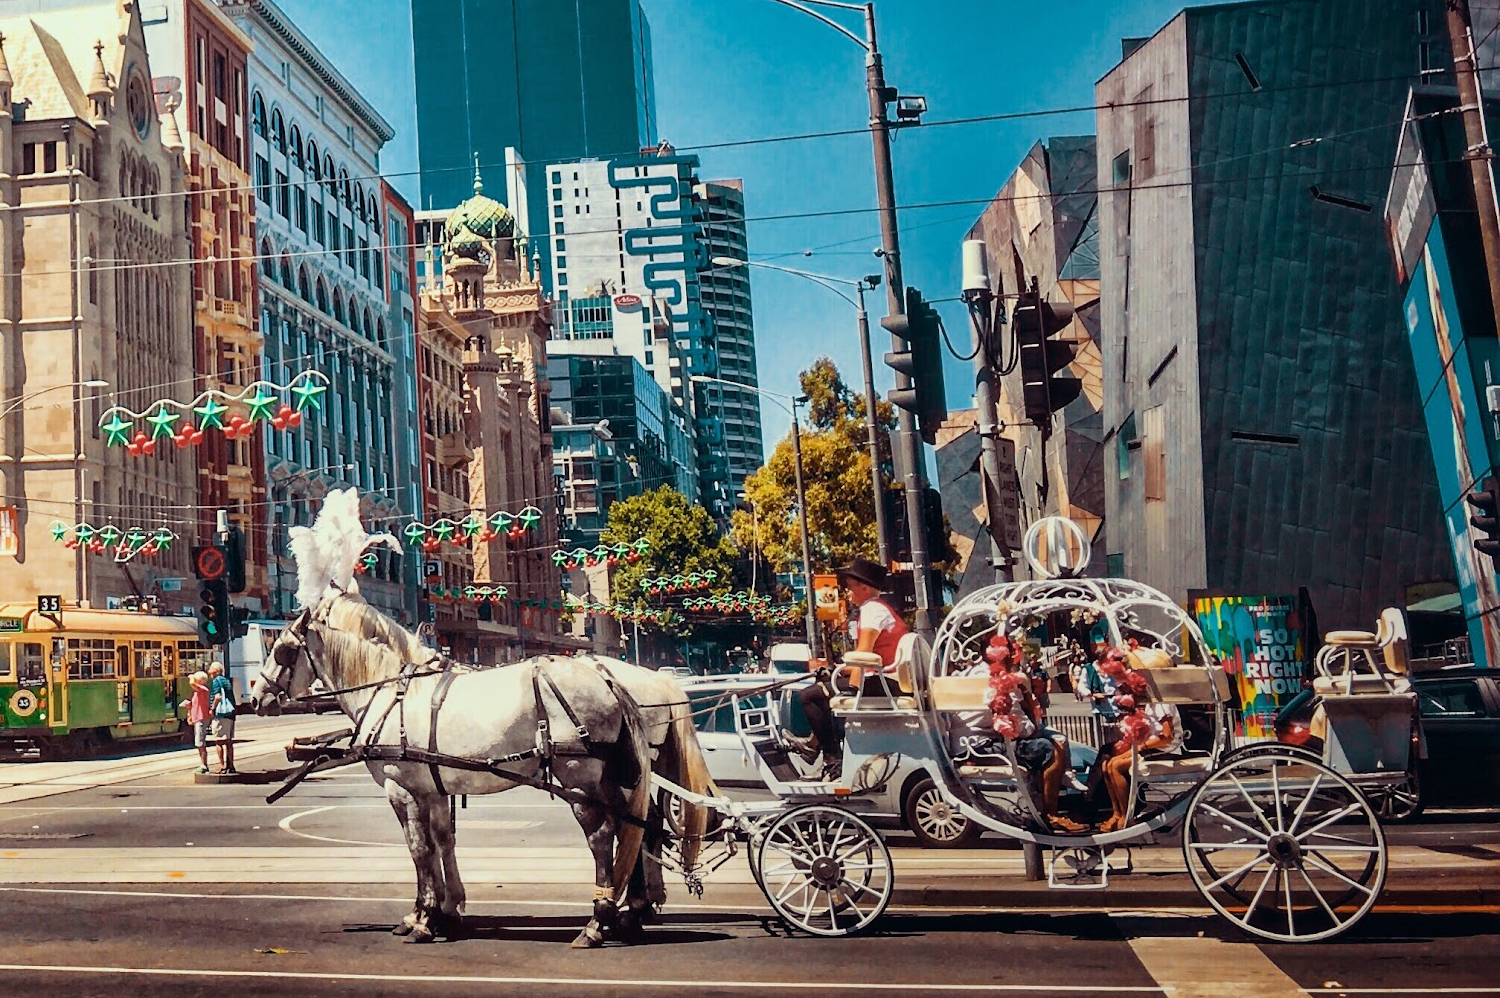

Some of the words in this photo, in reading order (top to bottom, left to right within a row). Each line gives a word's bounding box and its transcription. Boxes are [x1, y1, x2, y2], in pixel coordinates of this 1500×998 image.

[427, 564, 436, 576] P
[41, 598, 58, 611] 35
[1259, 628, 1288, 645] SO
[1254, 645, 1295, 661] HOT
[1245, 662, 1303, 678] RIGHT
[1254, 678, 1301, 694] NOW
[18, 698, 29, 707] 35
